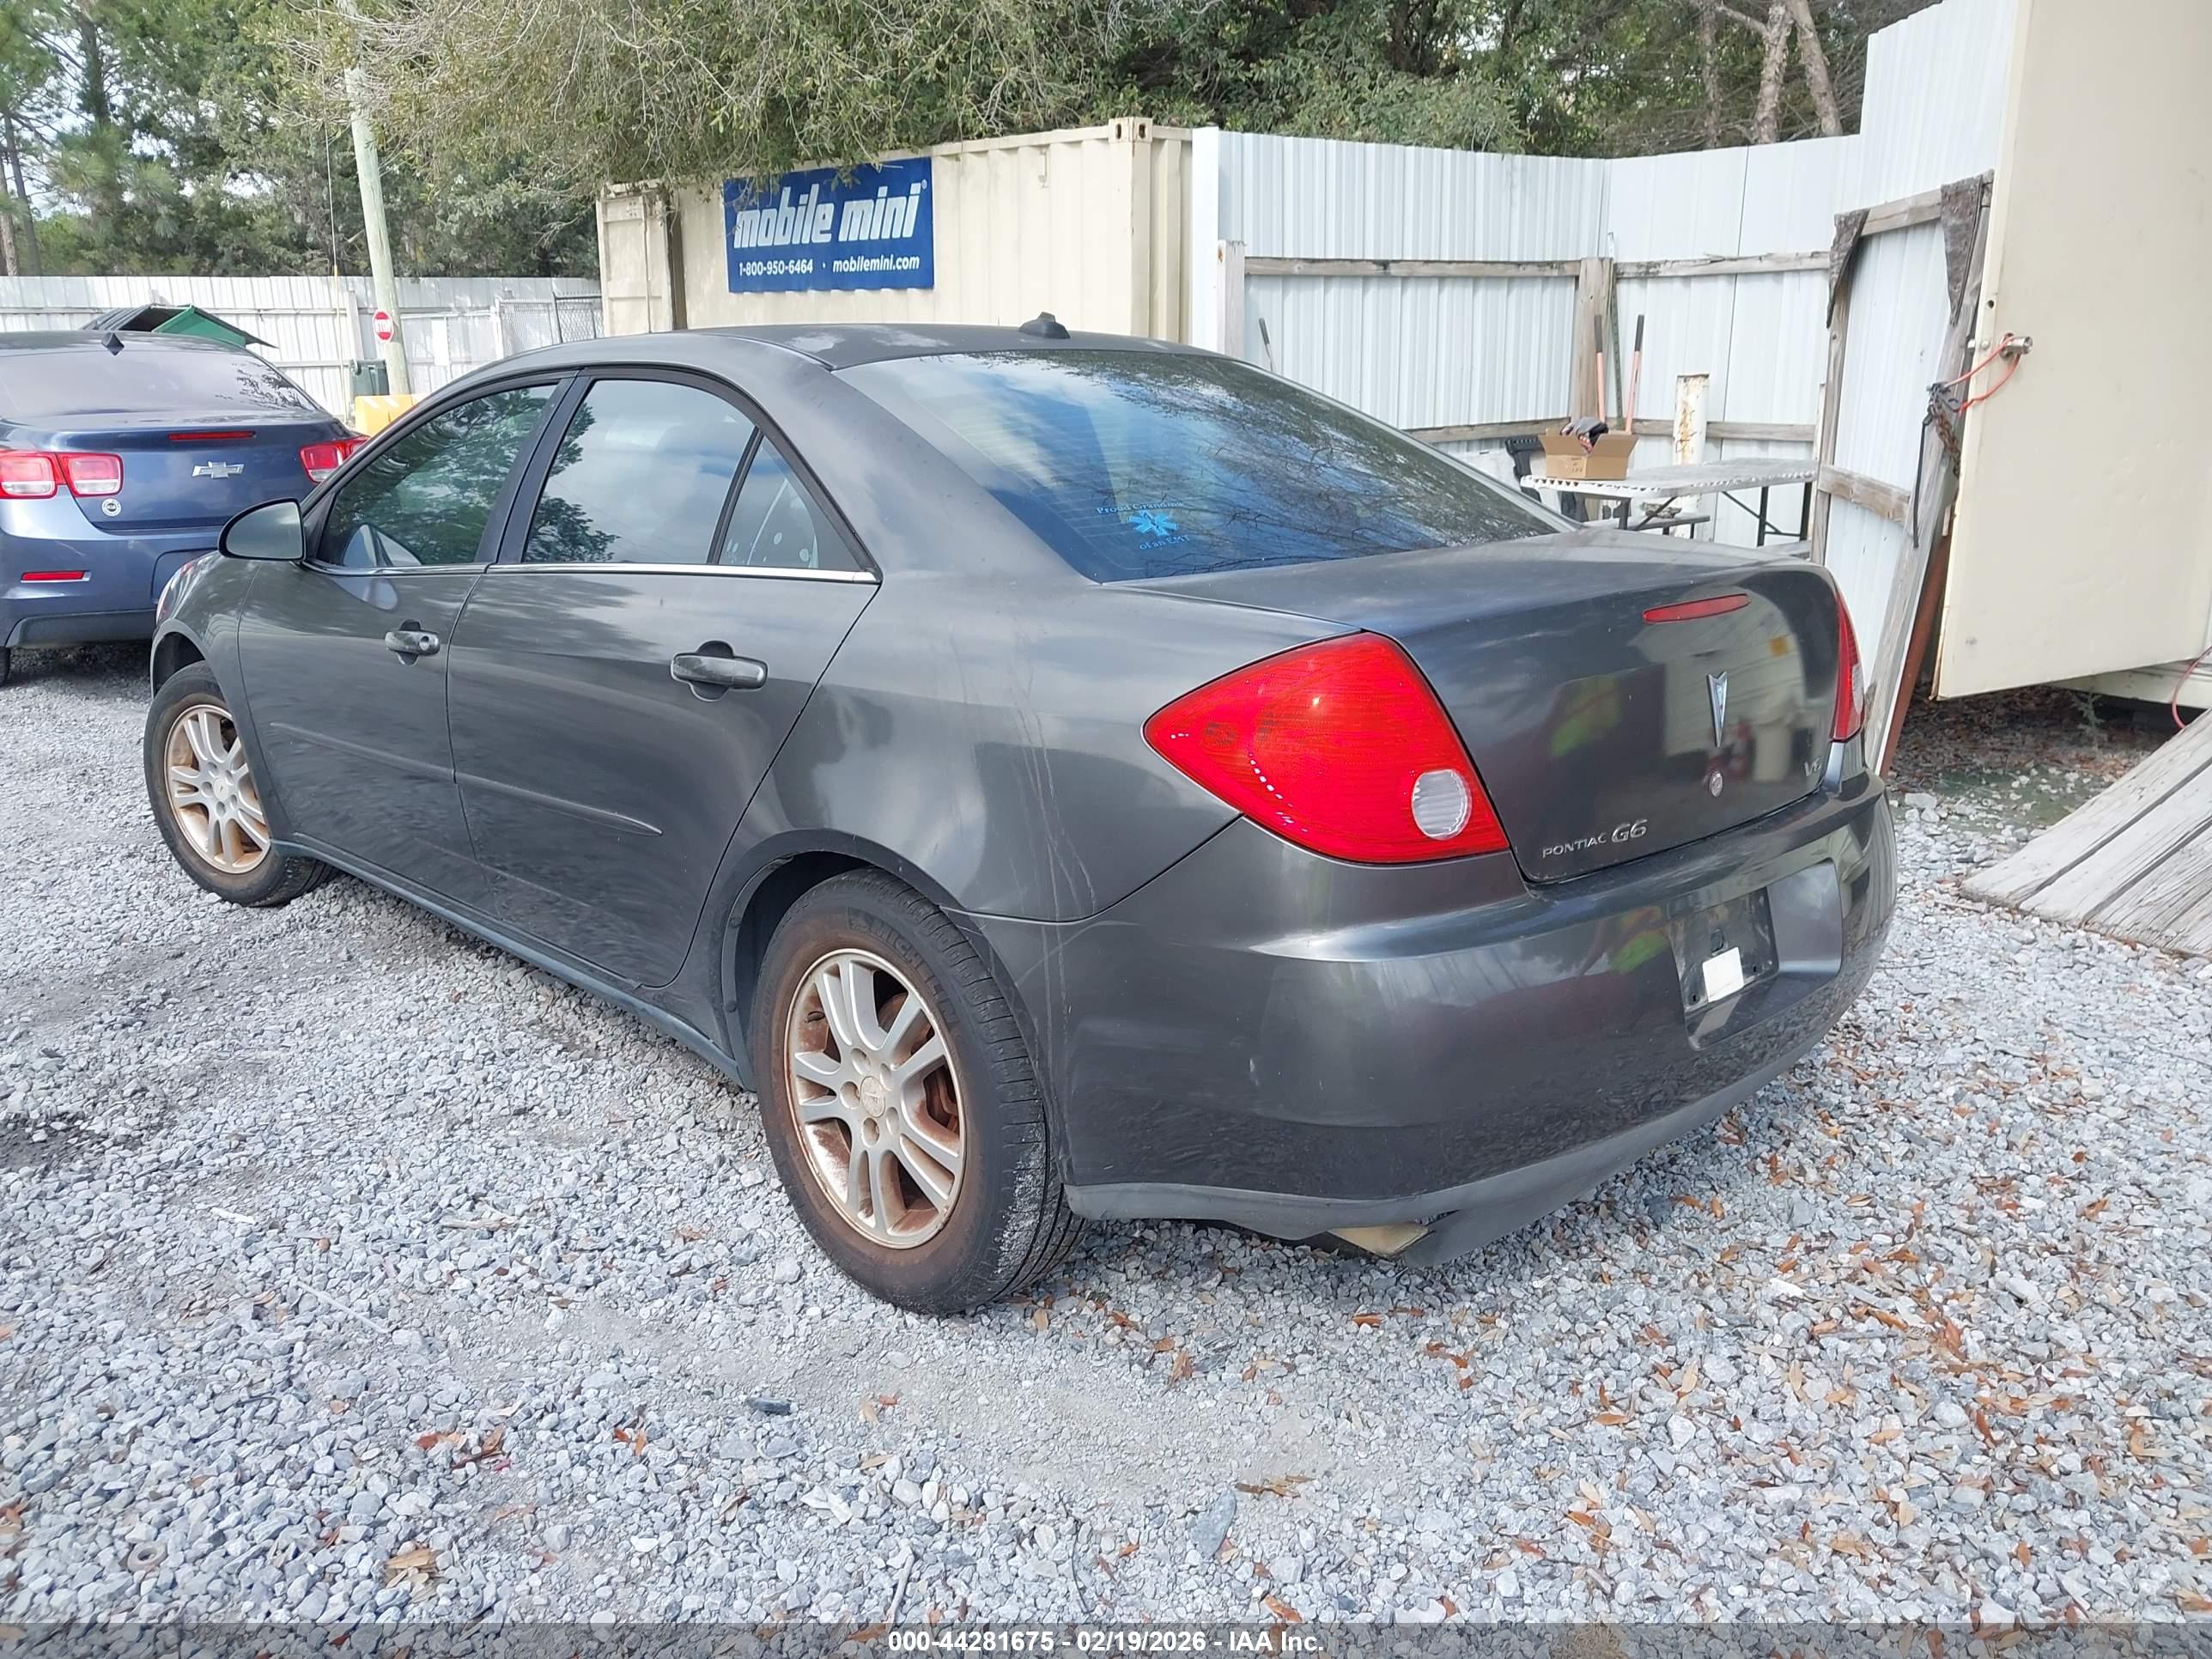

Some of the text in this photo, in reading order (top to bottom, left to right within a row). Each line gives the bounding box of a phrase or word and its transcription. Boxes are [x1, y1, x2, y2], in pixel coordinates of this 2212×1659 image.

[733, 182, 921, 248] mobile mini
[738, 253, 921, 276] 1-800-950-6464 mobilemini.com
[1097, 501, 1183, 514] Proud Grandma
[1166, 535, 1190, 544] EMT
[1542, 818, 1648, 859] PONTIAC G6
